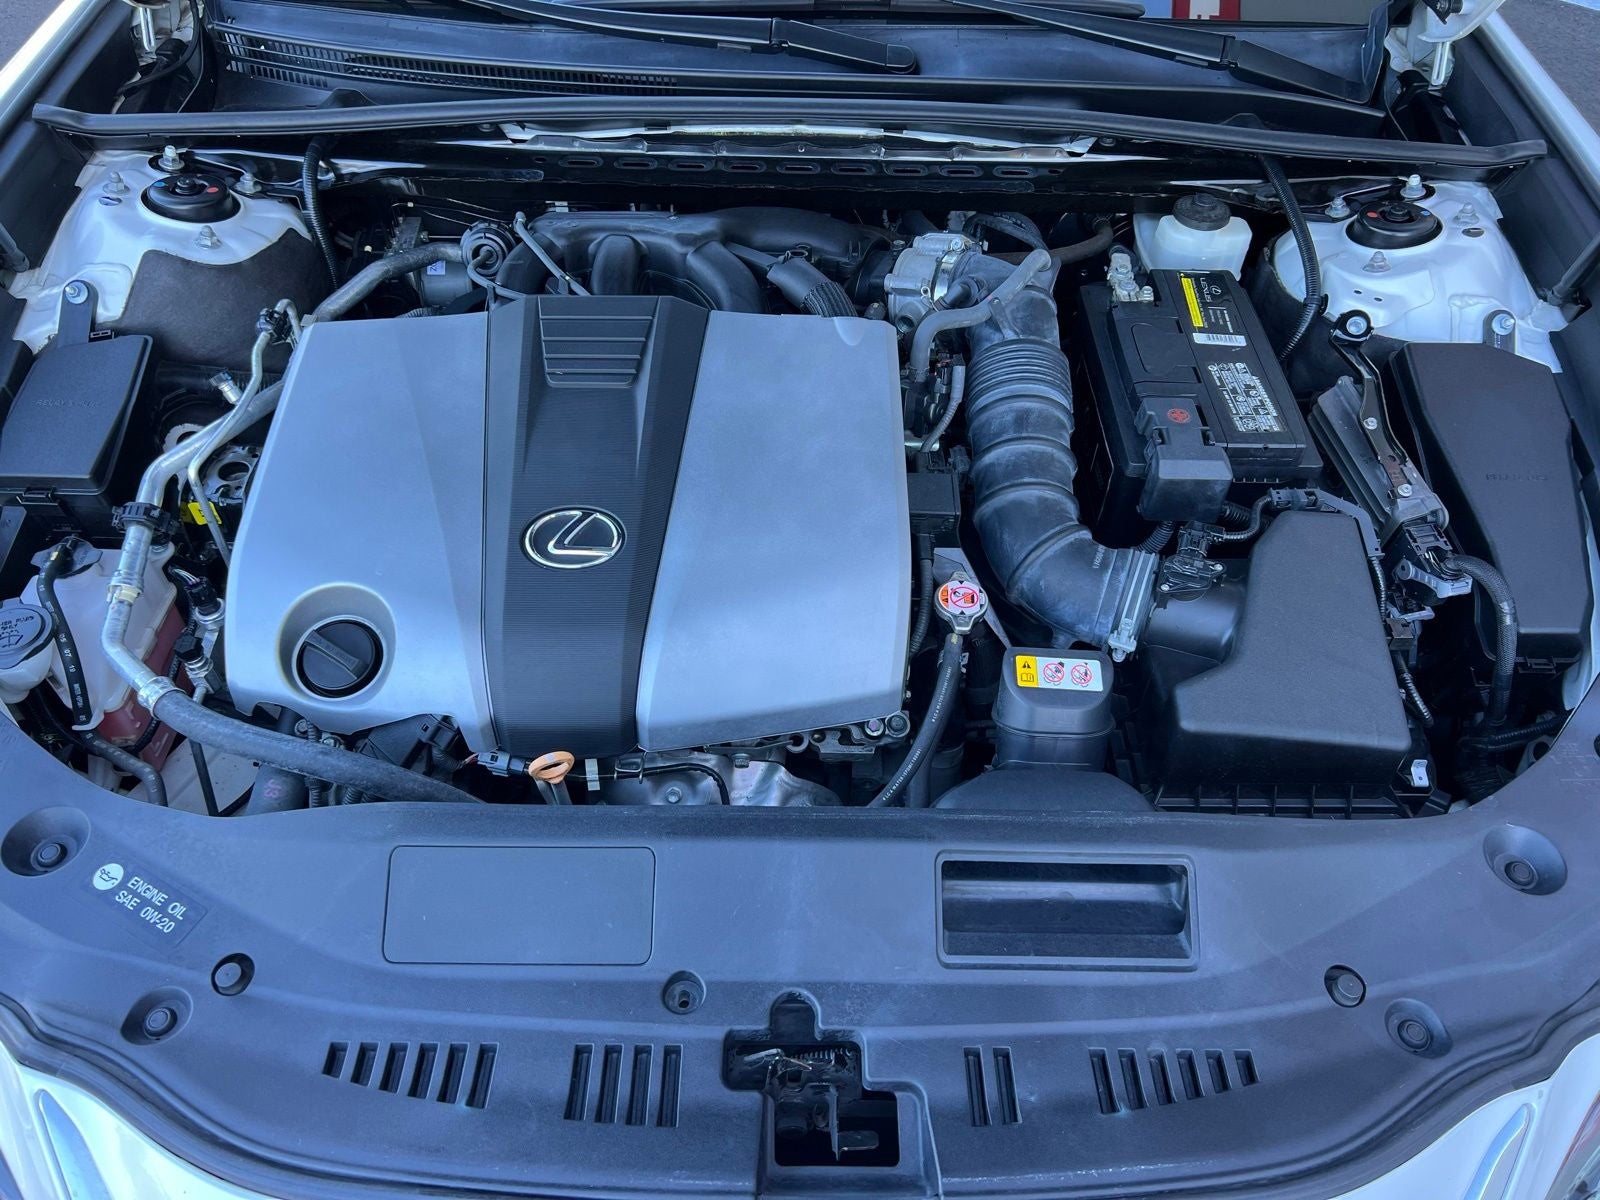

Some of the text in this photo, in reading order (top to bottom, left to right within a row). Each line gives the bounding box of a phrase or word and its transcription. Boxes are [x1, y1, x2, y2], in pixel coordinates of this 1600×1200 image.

[115, 890, 175, 933] SAE 0W-20
[127, 876, 187, 920] ENGINE OIL
